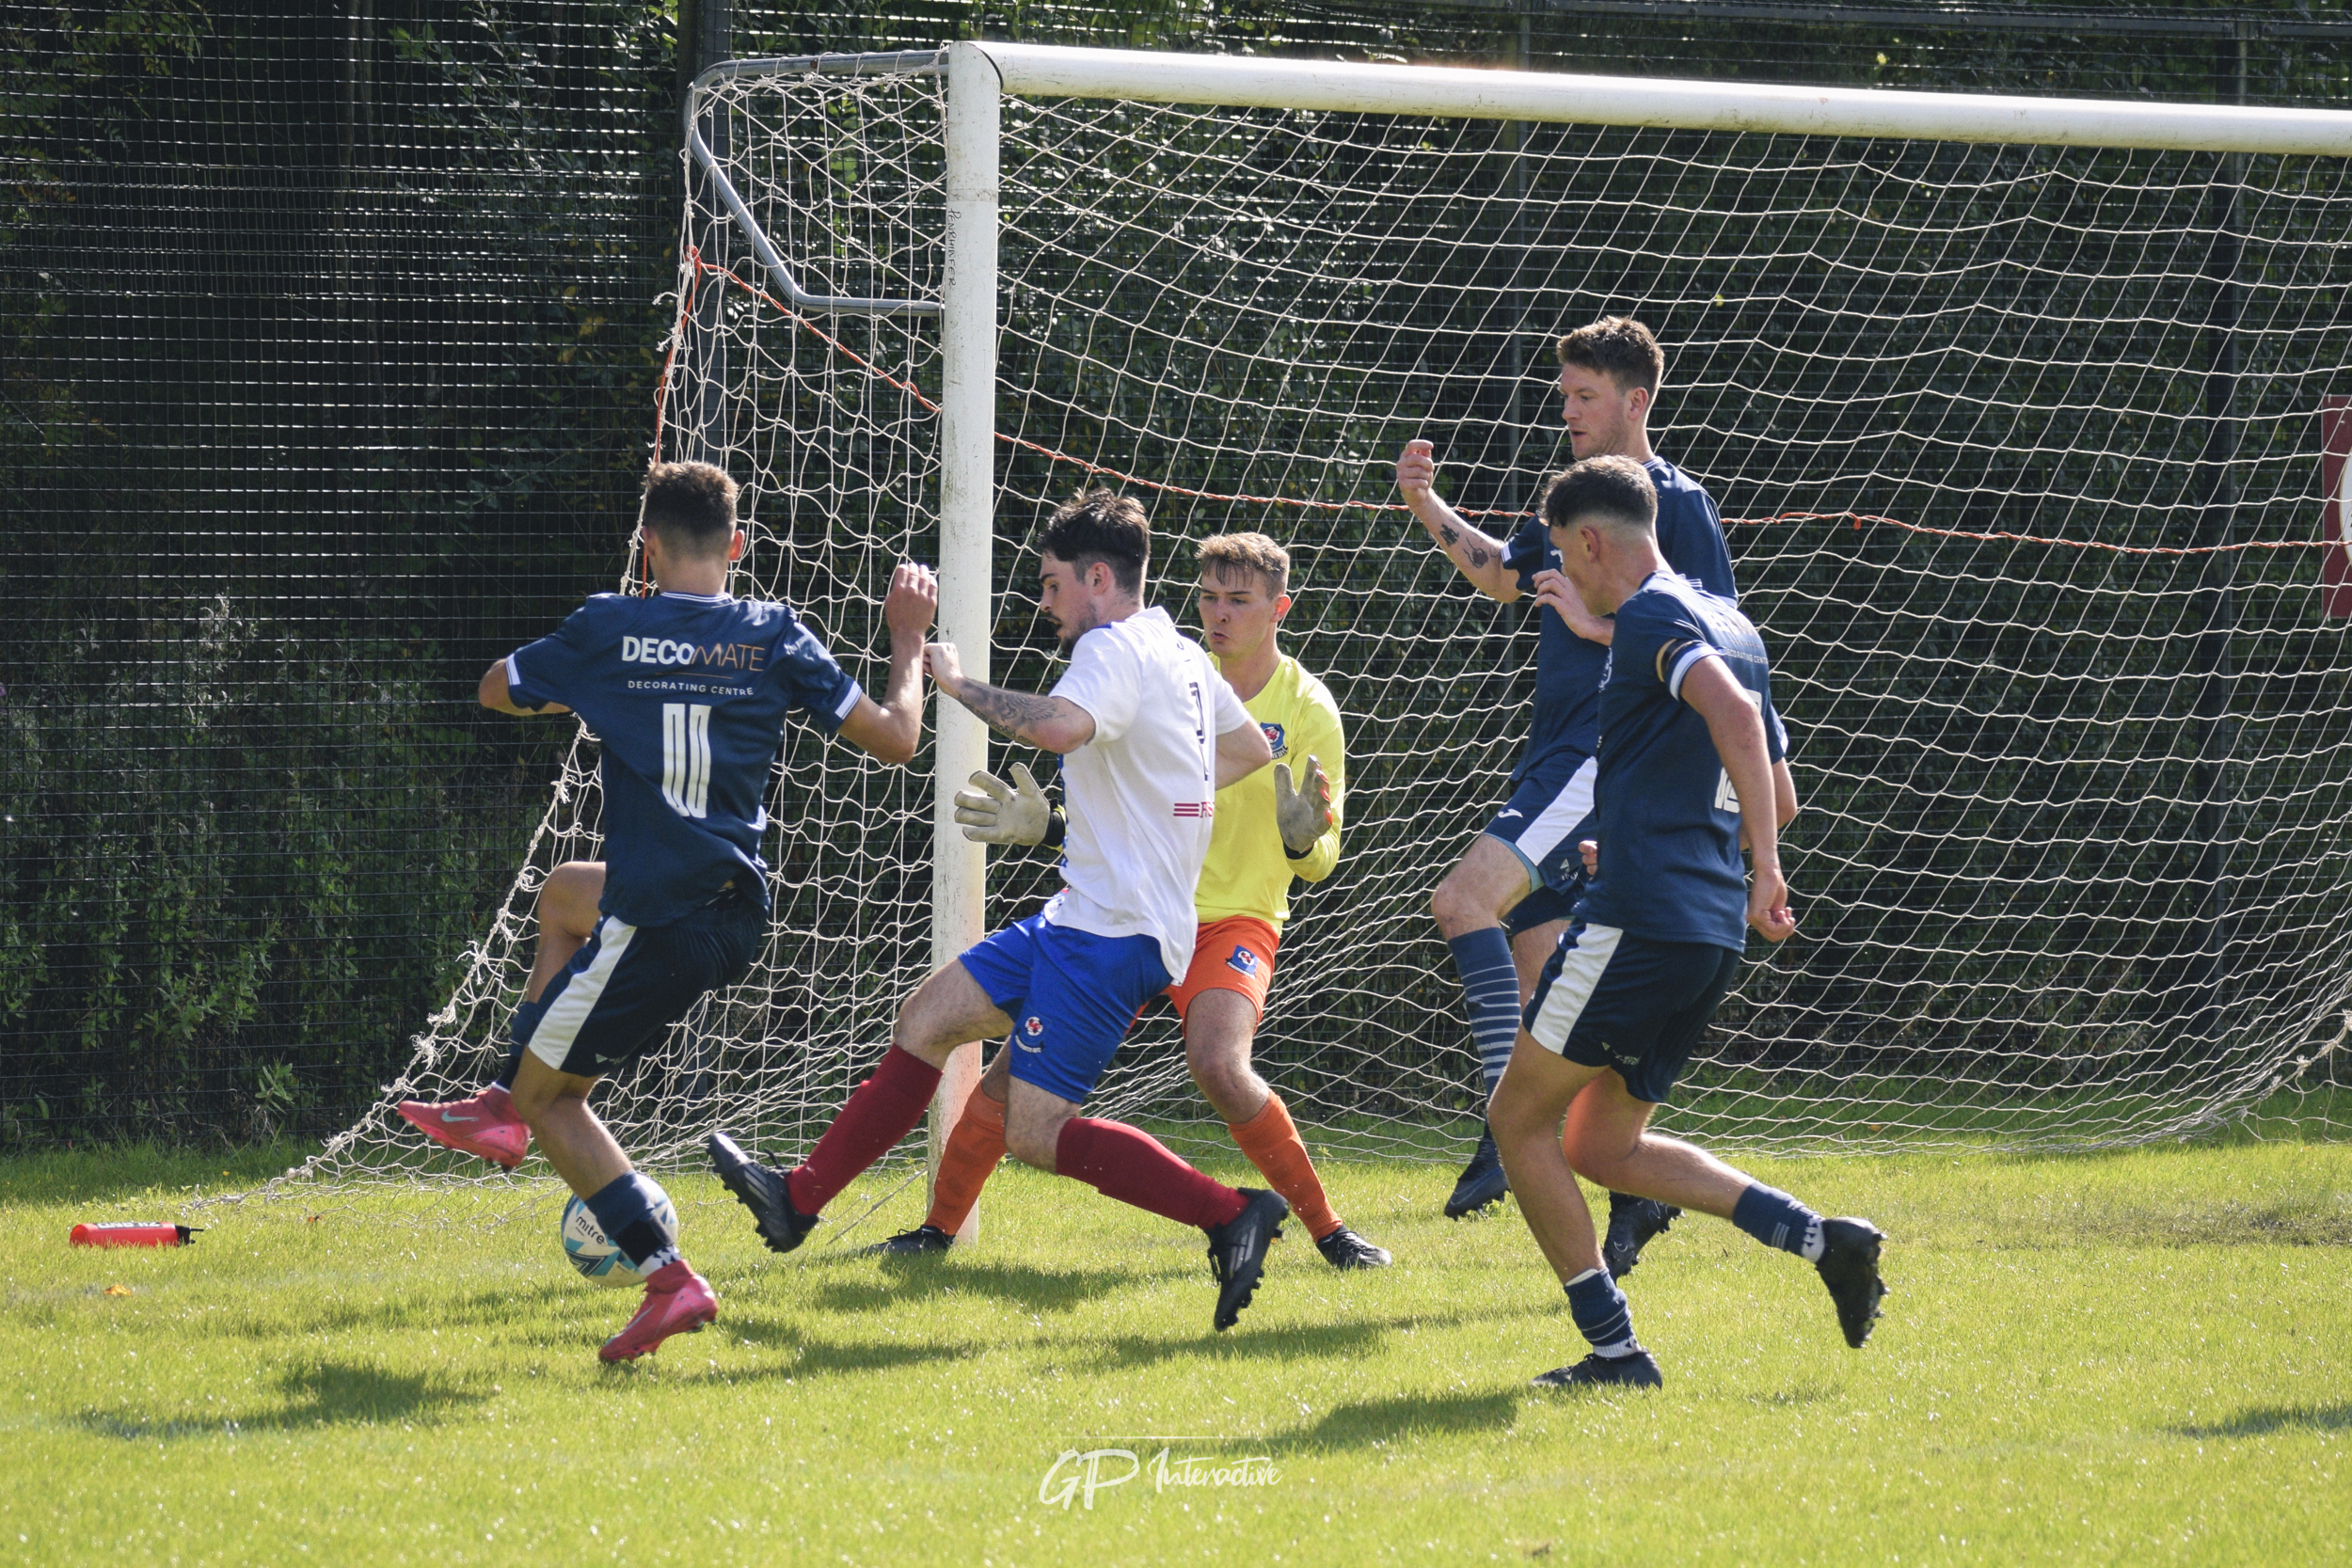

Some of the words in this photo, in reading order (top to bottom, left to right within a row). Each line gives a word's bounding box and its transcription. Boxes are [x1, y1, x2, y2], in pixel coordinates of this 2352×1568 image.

[621, 636, 766, 672] DECOMATE
[628, 680, 707, 693] DECORATING
[710, 686, 755, 696] CENTRE
[576, 1216, 605, 1244] mitre
